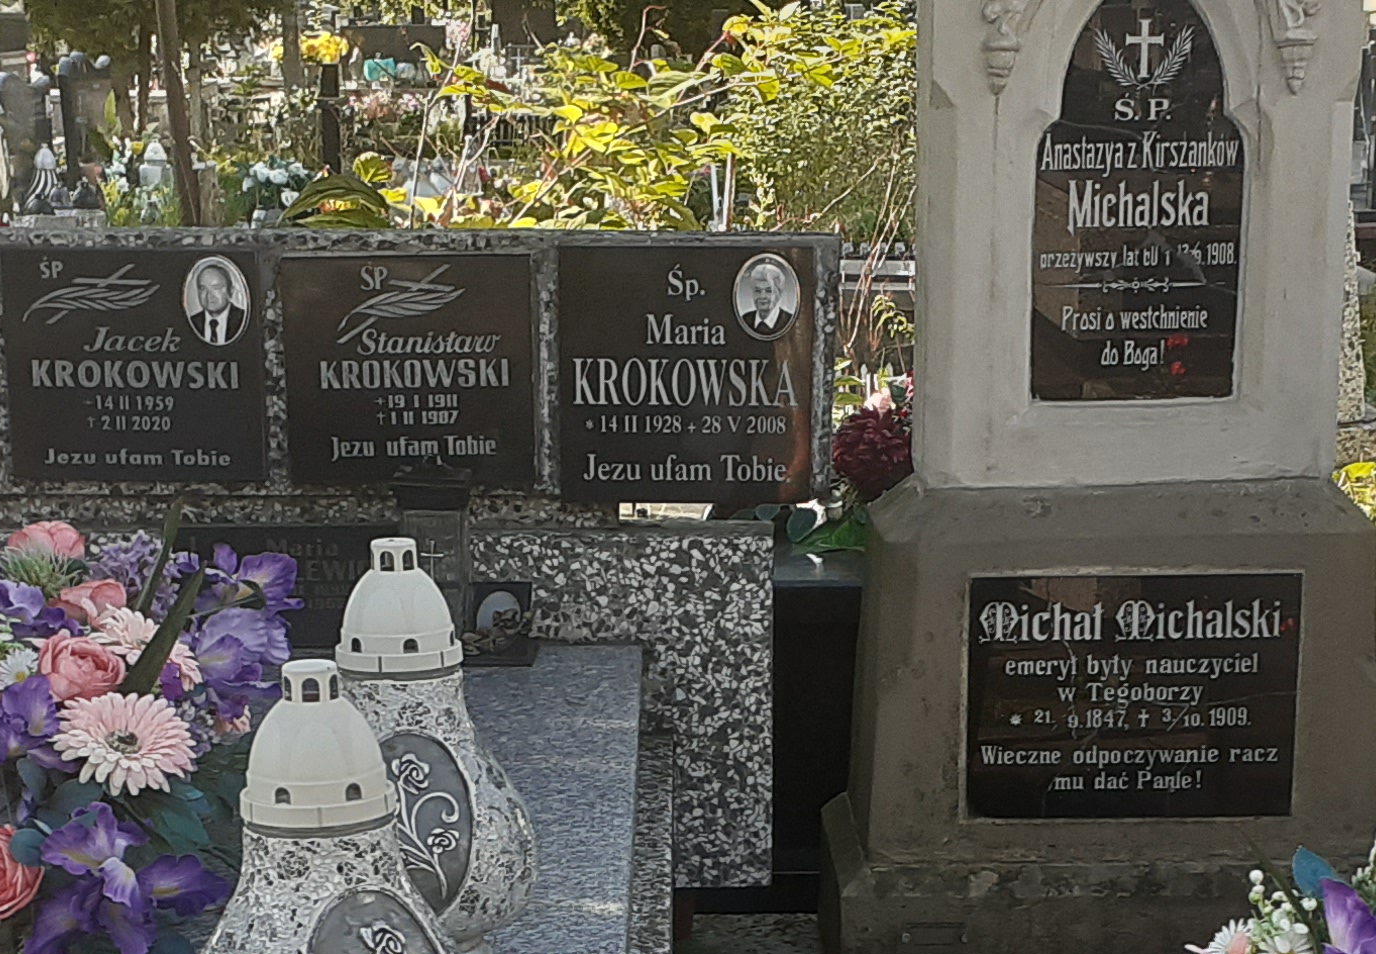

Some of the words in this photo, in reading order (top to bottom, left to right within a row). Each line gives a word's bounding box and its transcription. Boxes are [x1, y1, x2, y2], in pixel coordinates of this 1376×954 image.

[1040, 133, 1123, 178] Anastazya
[1127, 142, 1138, 169] z
[1067, 179, 1210, 236] Michalska
[1123, 244, 1140, 266] lat
[667, 264, 706, 301] Śp.
[646, 314, 726, 346] Maria
[1061, 306, 1101, 331] Prosi
[1105, 312, 1114, 330] o
[1120, 305, 1208, 330] westchnienie
[83, 326, 182, 352] Jacek
[357, 328, 501, 355] Stanisław
[1101, 341, 1119, 366] do
[1123, 339, 1165, 371] Boga!
[31, 359, 240, 389] KROKOWSKI
[320, 358, 510, 389] KROKOWSKI
[573, 358, 798, 407] KROKOWSKA
[96, 395, 115, 410] 14
[136, 395, 175, 411] 1959
[388, 394, 405, 408] 19
[428, 393, 458, 408] 1911
[101, 415, 112, 430] 2
[132, 415, 172, 431] 2020
[600, 415, 618, 433] 14
[624, 415, 638, 433] II
[645, 415, 682, 433] 1928
[702, 415, 722, 433] 28
[727, 416, 741, 433] V
[746, 416, 786, 434] 2008
[44, 448, 96, 465] Jezu
[105, 448, 164, 466] ufam
[171, 449, 232, 467] Tobie
[331, 437, 375, 462] Jezu
[387, 435, 439, 457] ufam
[444, 434, 497, 456] Tobie
[583, 454, 641, 481] Jezu
[650, 454, 711, 481] ufam
[720, 454, 791, 483] Tobie.
[979, 601, 1105, 643] Michał
[1115, 599, 1281, 643] Michalski
[1146, 652, 1258, 679] nauczyciel
[1058, 688, 1076, 702] w
[1087, 682, 1203, 710] Tegoborzy
[981, 745, 1061, 764] Wieczne
[1073, 745, 1219, 768] odpoczywanie
[1229, 747, 1279, 763] racz
[1054, 777, 1084, 790] mu
[1094, 771, 1129, 790] dać
[1136, 769, 1202, 792] Panie!
